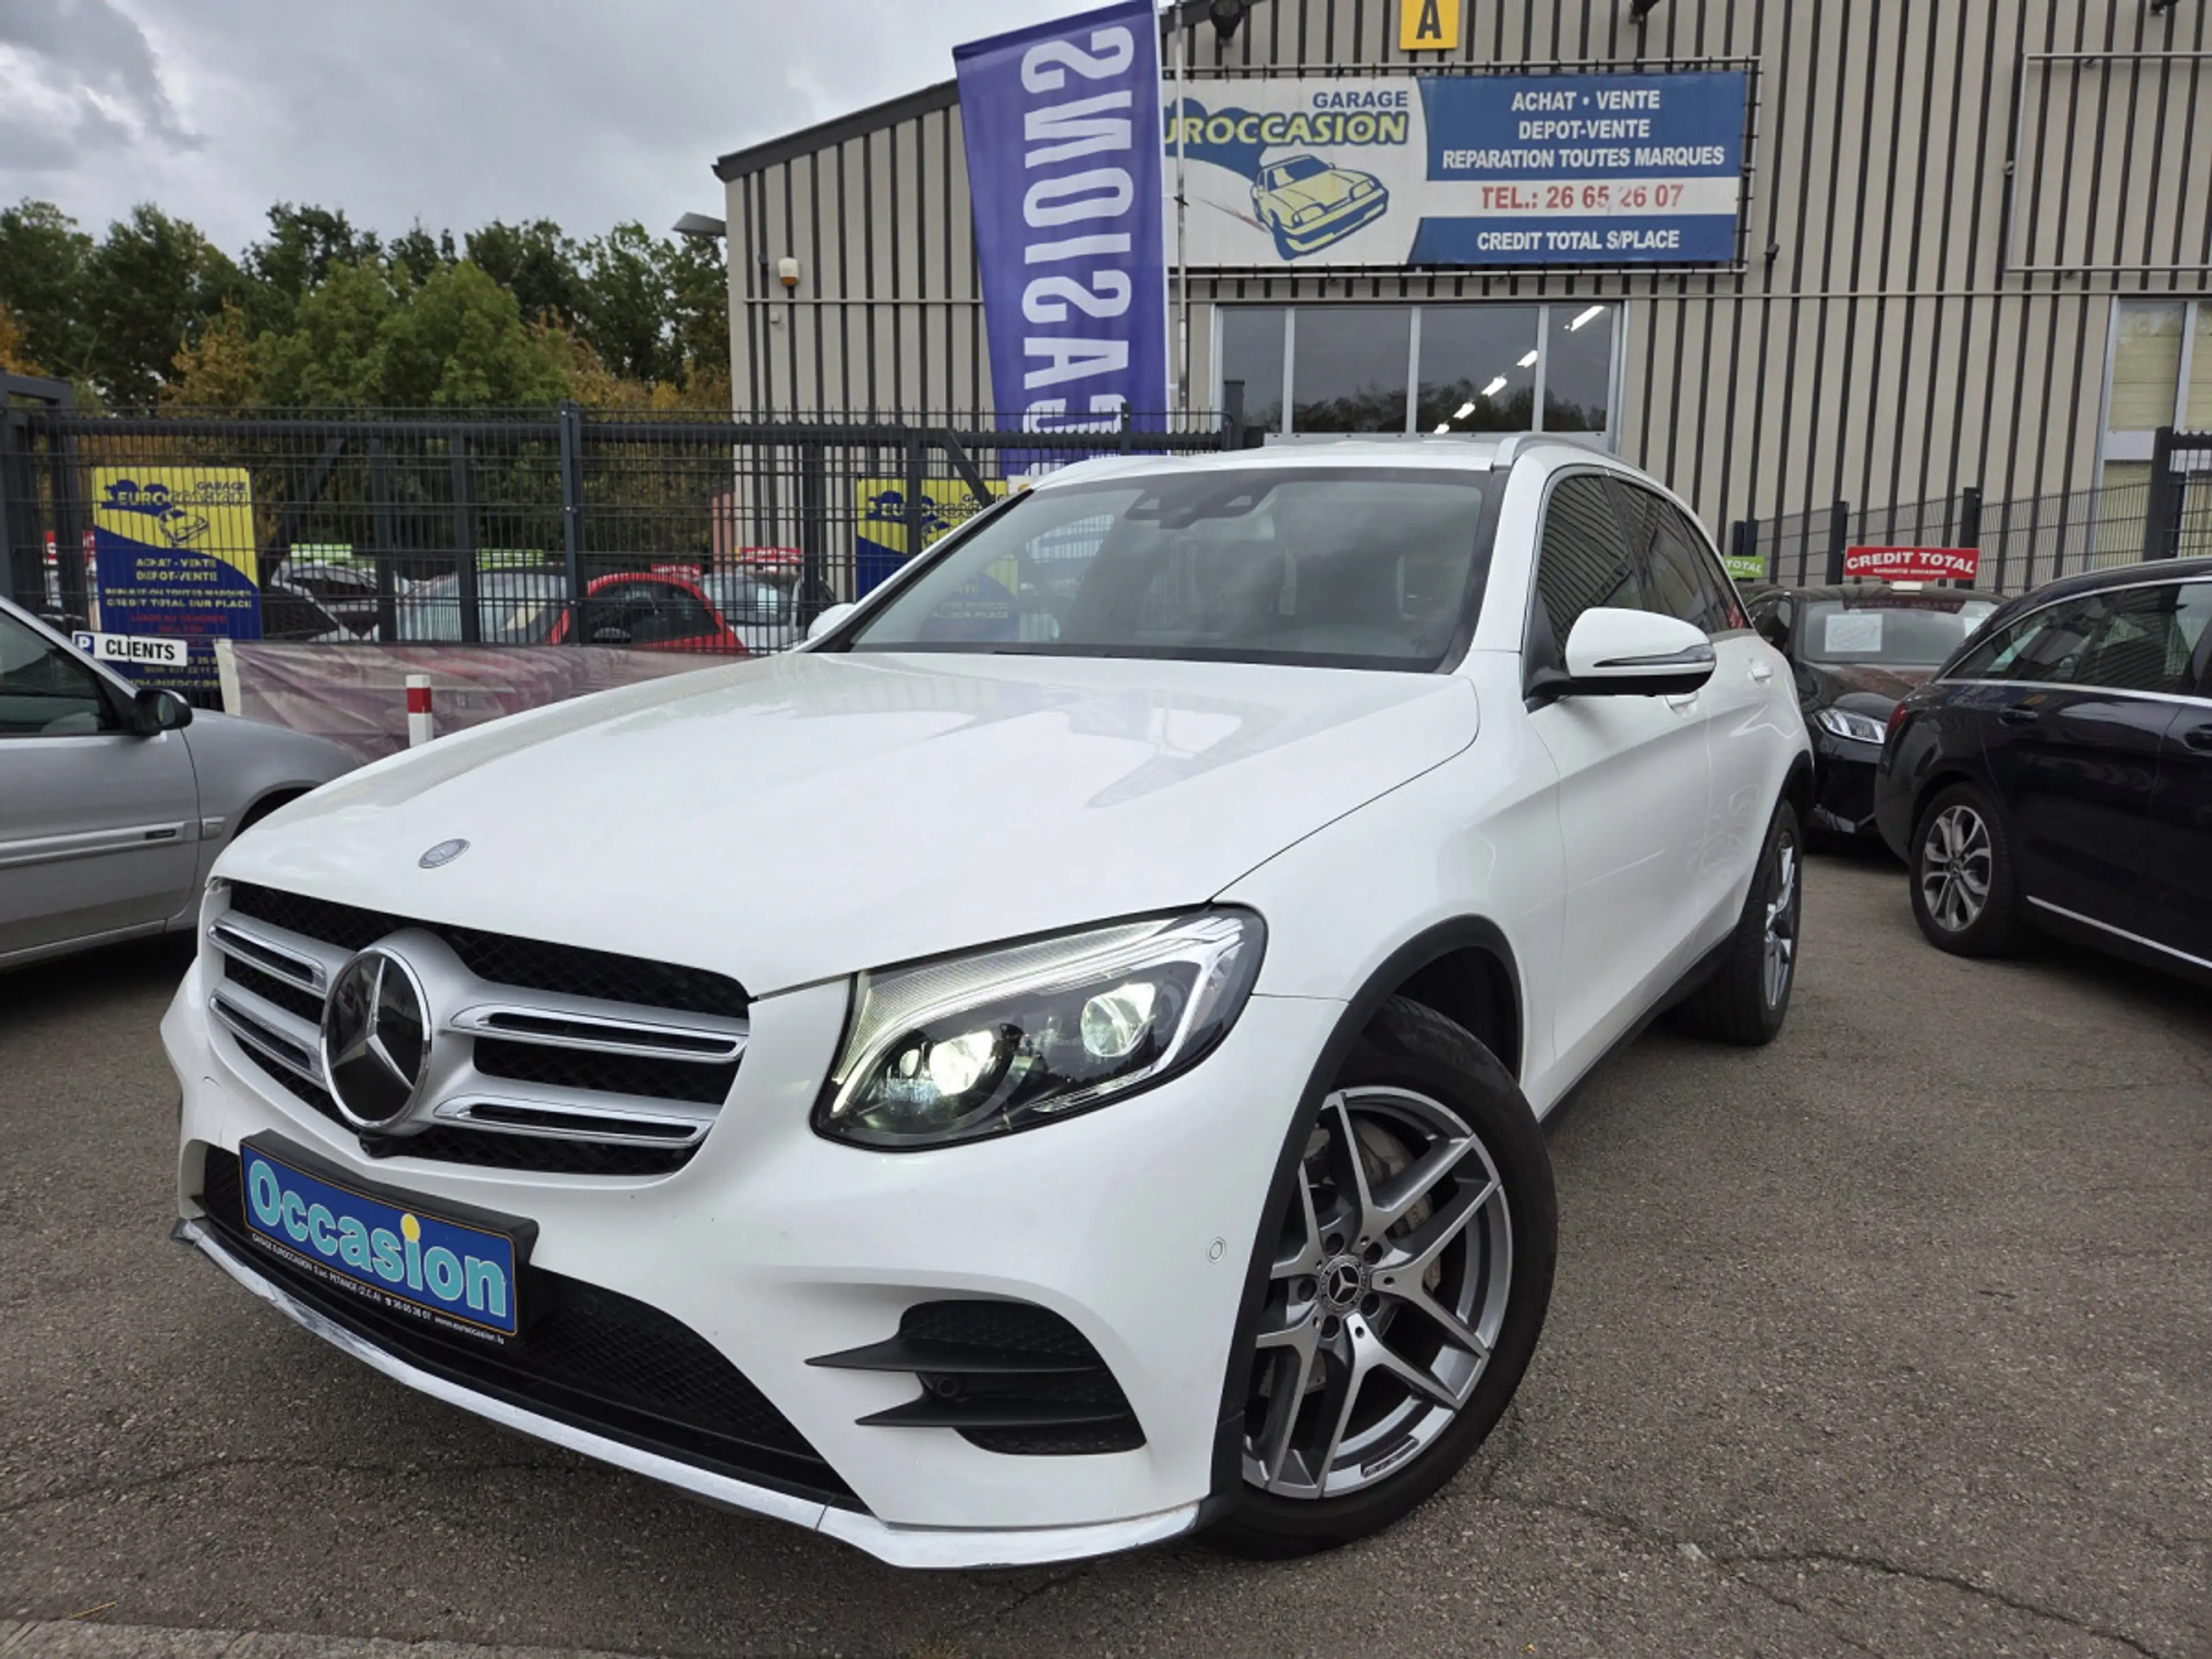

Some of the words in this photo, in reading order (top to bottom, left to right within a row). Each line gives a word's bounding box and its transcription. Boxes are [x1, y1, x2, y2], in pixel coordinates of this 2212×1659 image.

[1416, 0, 1442, 39] A
[1312, 90, 1408, 108] GARAGE
[1511, 92, 1577, 111] ACHAT
[1596, 90, 1661, 109] VENTE
[1519, 119, 1651, 139] DEPOT-VENTE
[1442, 149, 1555, 169] REPARATION
[1559, 148, 1631, 168] TOUTES
[1634, 146, 1725, 166] MARQUES
[1482, 186, 1537, 210] TEL.:
[1546, 185, 1574, 209] 26
[1582, 185, 1610, 209] 65
[1619, 185, 1647, 208] 26
[1654, 184, 1683, 207] 07
[1477, 232, 1542, 251] CREDIT
[1547, 231, 1603, 250] TOTAL
[1606, 230, 1680, 249] S/PLACE
[1846, 551, 1914, 569] CREDIT
[1919, 551, 1975, 574] TOTAL
[105, 639, 176, 661] CLIENTS
[249, 1159, 506, 1317] Occasion
